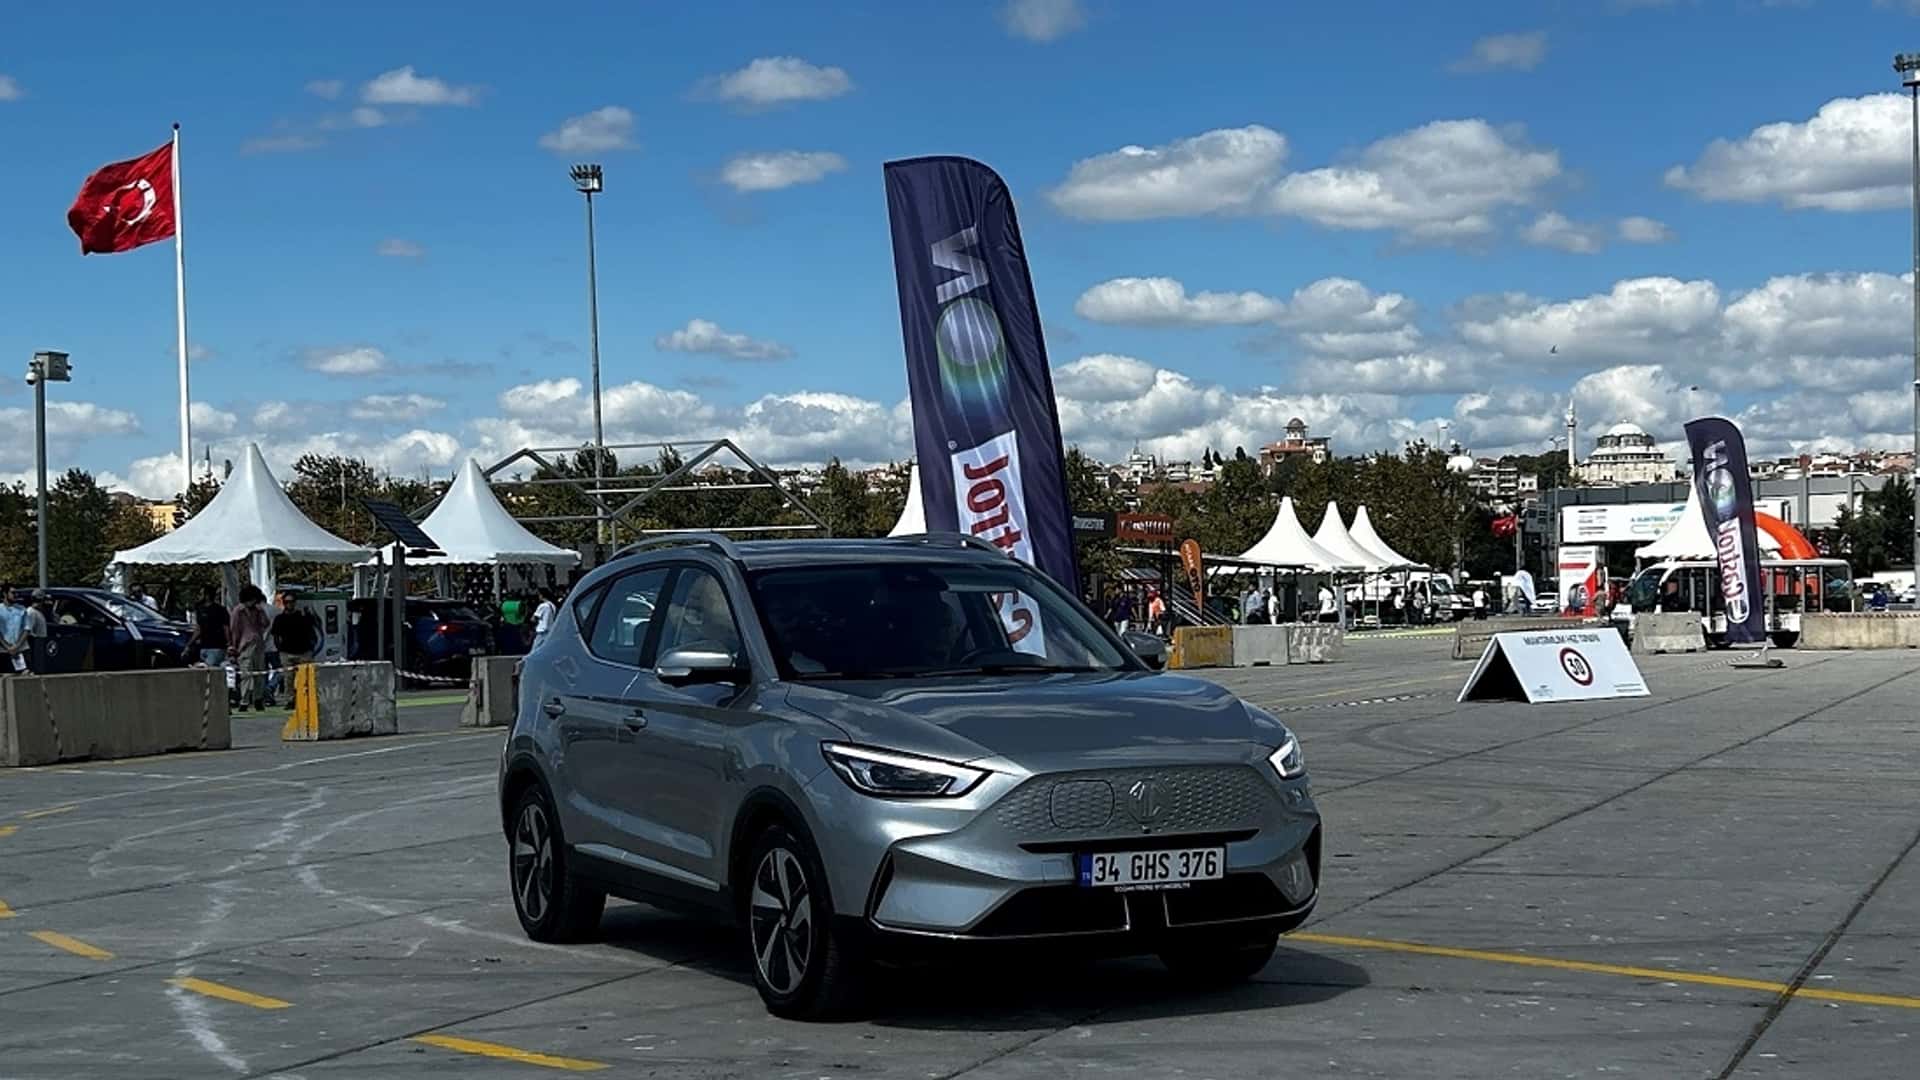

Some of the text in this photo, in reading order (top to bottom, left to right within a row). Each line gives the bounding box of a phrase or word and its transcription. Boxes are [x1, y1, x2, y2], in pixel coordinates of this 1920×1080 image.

[1567, 657, 1586, 676] 30
[1094, 850, 1217, 882] 34 GHS 376
